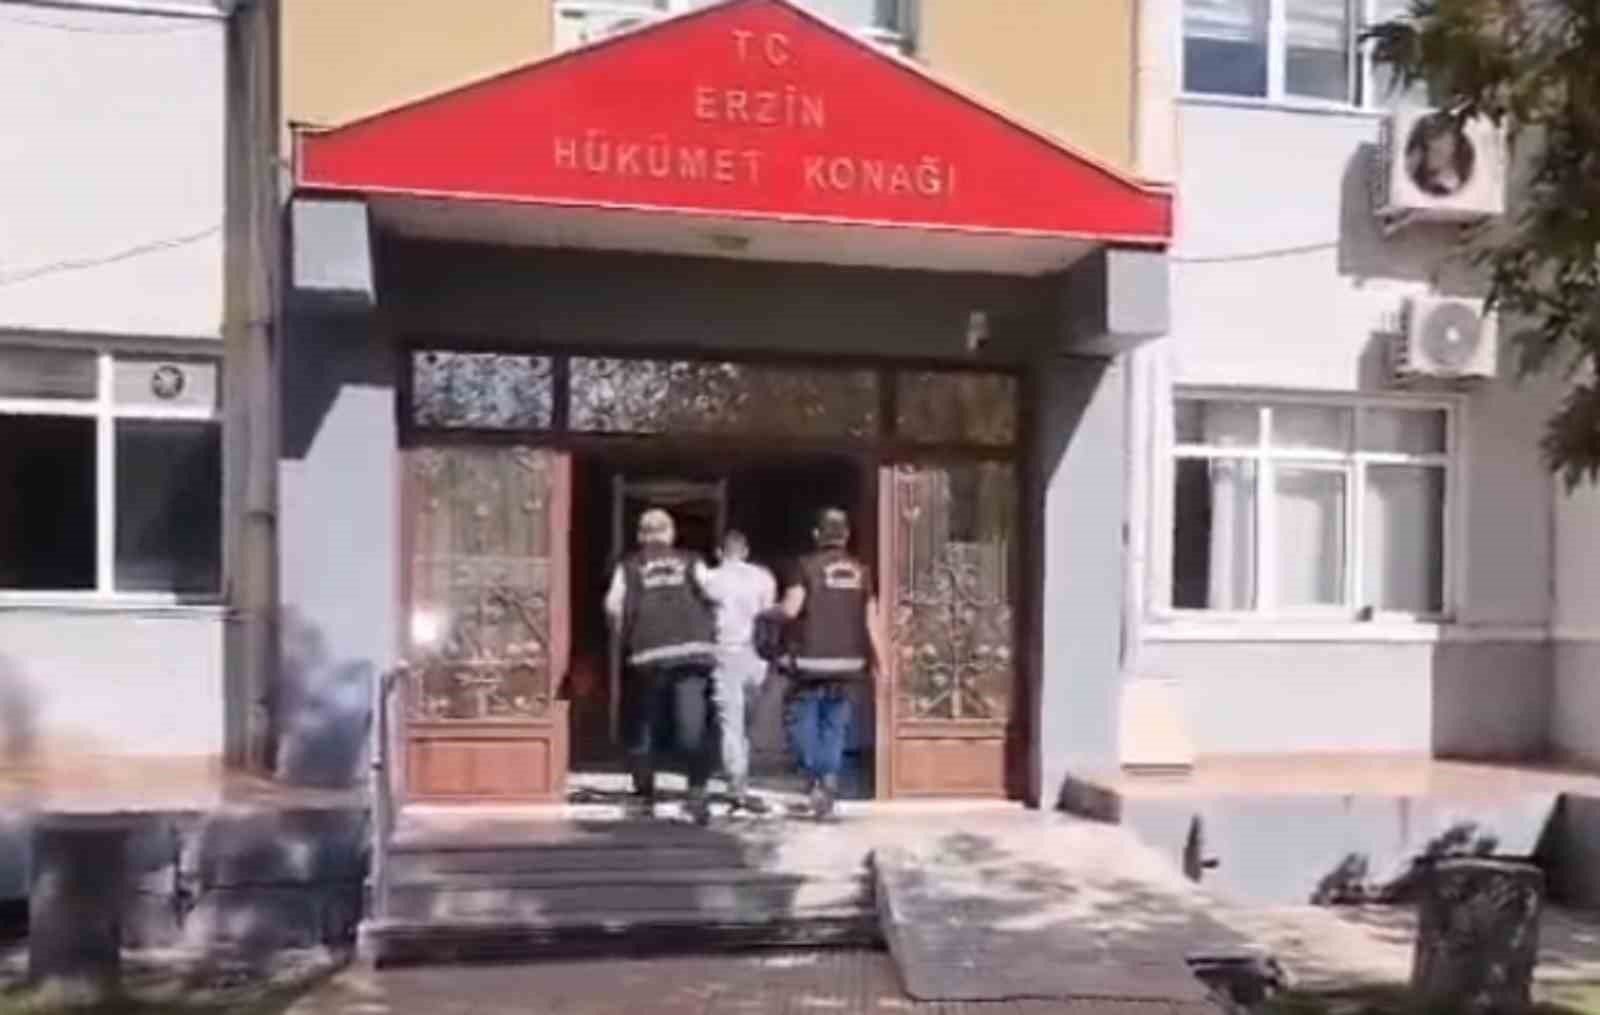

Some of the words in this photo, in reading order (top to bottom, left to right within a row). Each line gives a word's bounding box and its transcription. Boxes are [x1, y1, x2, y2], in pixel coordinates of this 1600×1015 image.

[693, 84, 826, 129] ERZİN
[553, 127, 766, 186] HÜKÜMET
[803, 153, 957, 199] KONAĞI
